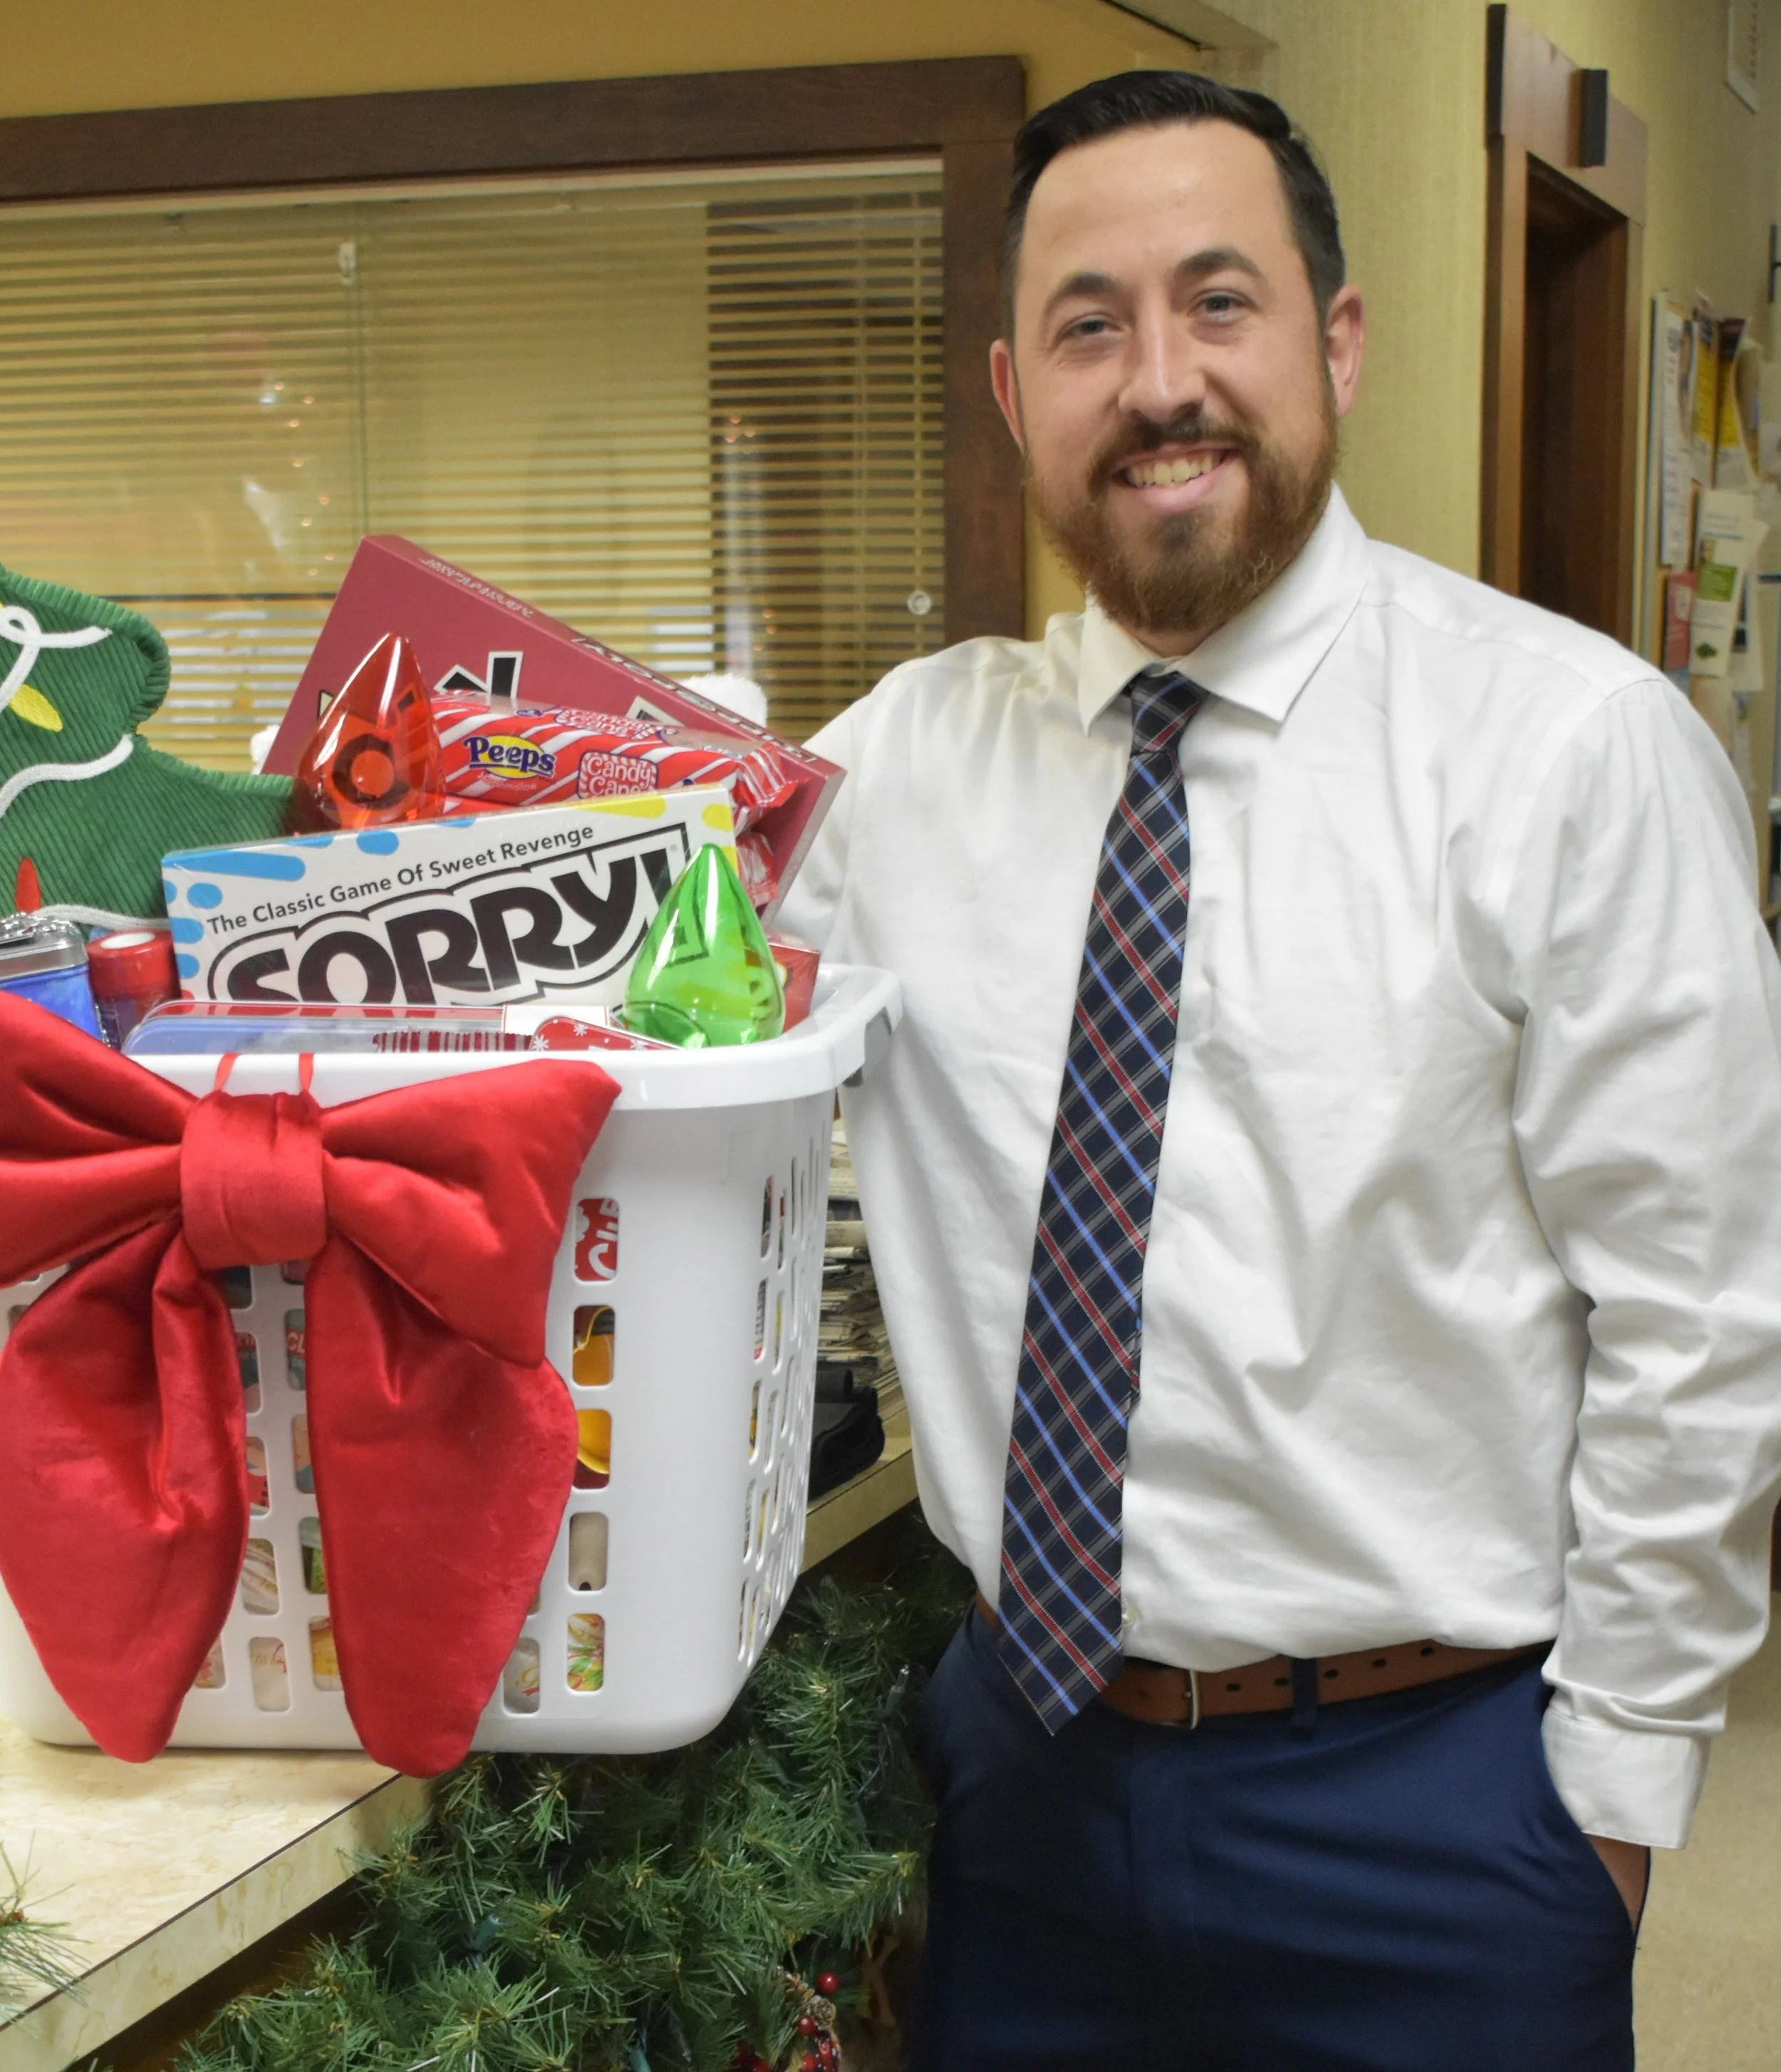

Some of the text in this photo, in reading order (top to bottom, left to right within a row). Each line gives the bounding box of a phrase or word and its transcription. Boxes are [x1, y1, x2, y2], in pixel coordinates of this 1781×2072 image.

[464, 736, 556, 776] Peeps
[586, 755, 652, 788] Candy
[207, 826, 593, 935] The Classic Game Of Sweet Revenge
